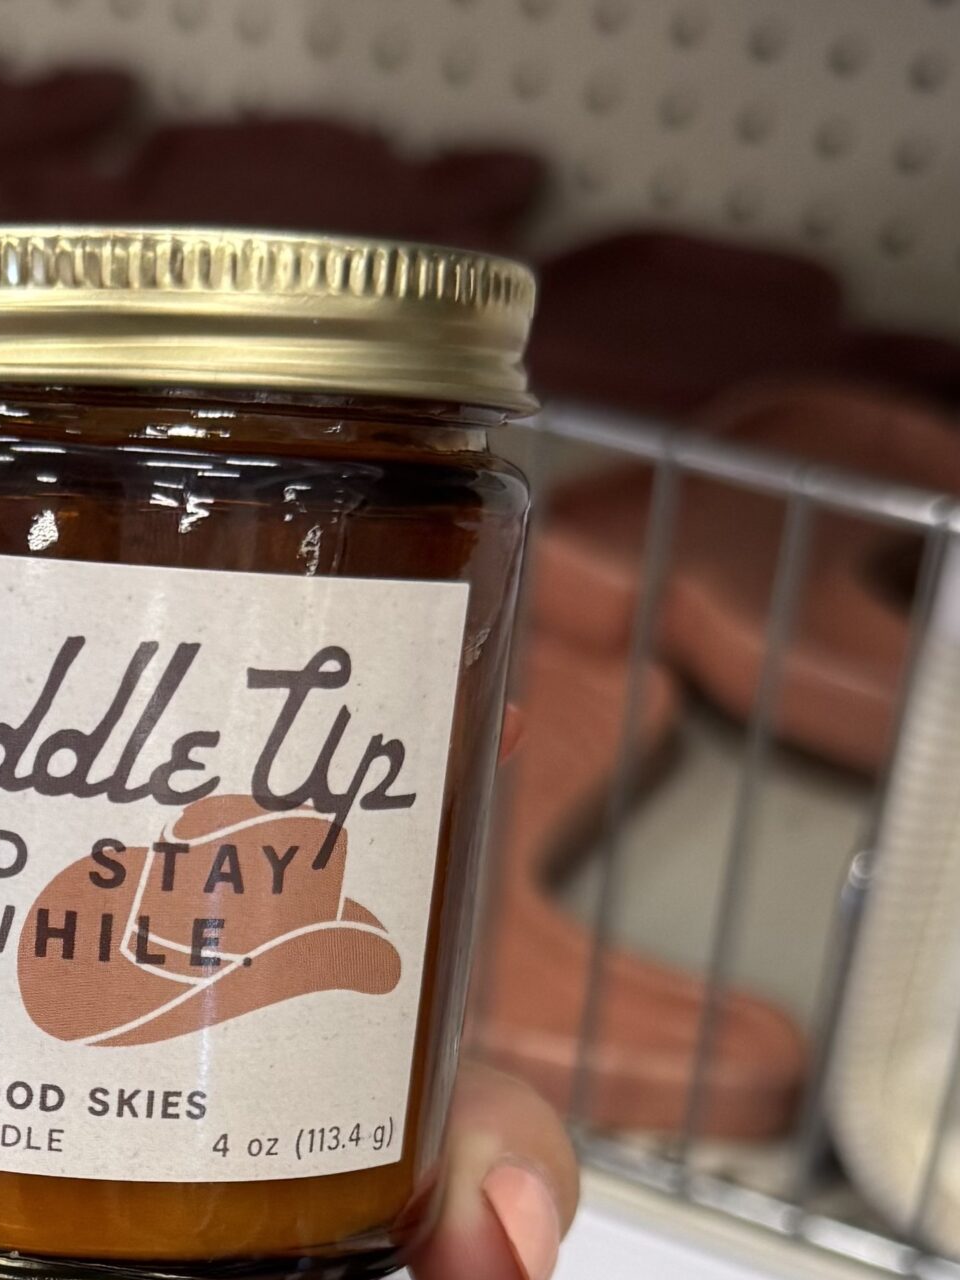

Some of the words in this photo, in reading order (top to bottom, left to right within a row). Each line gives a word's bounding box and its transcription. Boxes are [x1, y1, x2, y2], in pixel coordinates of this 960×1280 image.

[246, 646, 416, 869] Up
[89, 838, 300, 895] STAY
[88, 1088, 207, 1119] SKIES
[212, 1134, 229, 1158] 4
[248, 1136, 279, 1157] oz
[296, 1122, 361, 1159] (113.4
[372, 1117, 394, 1150] g)
